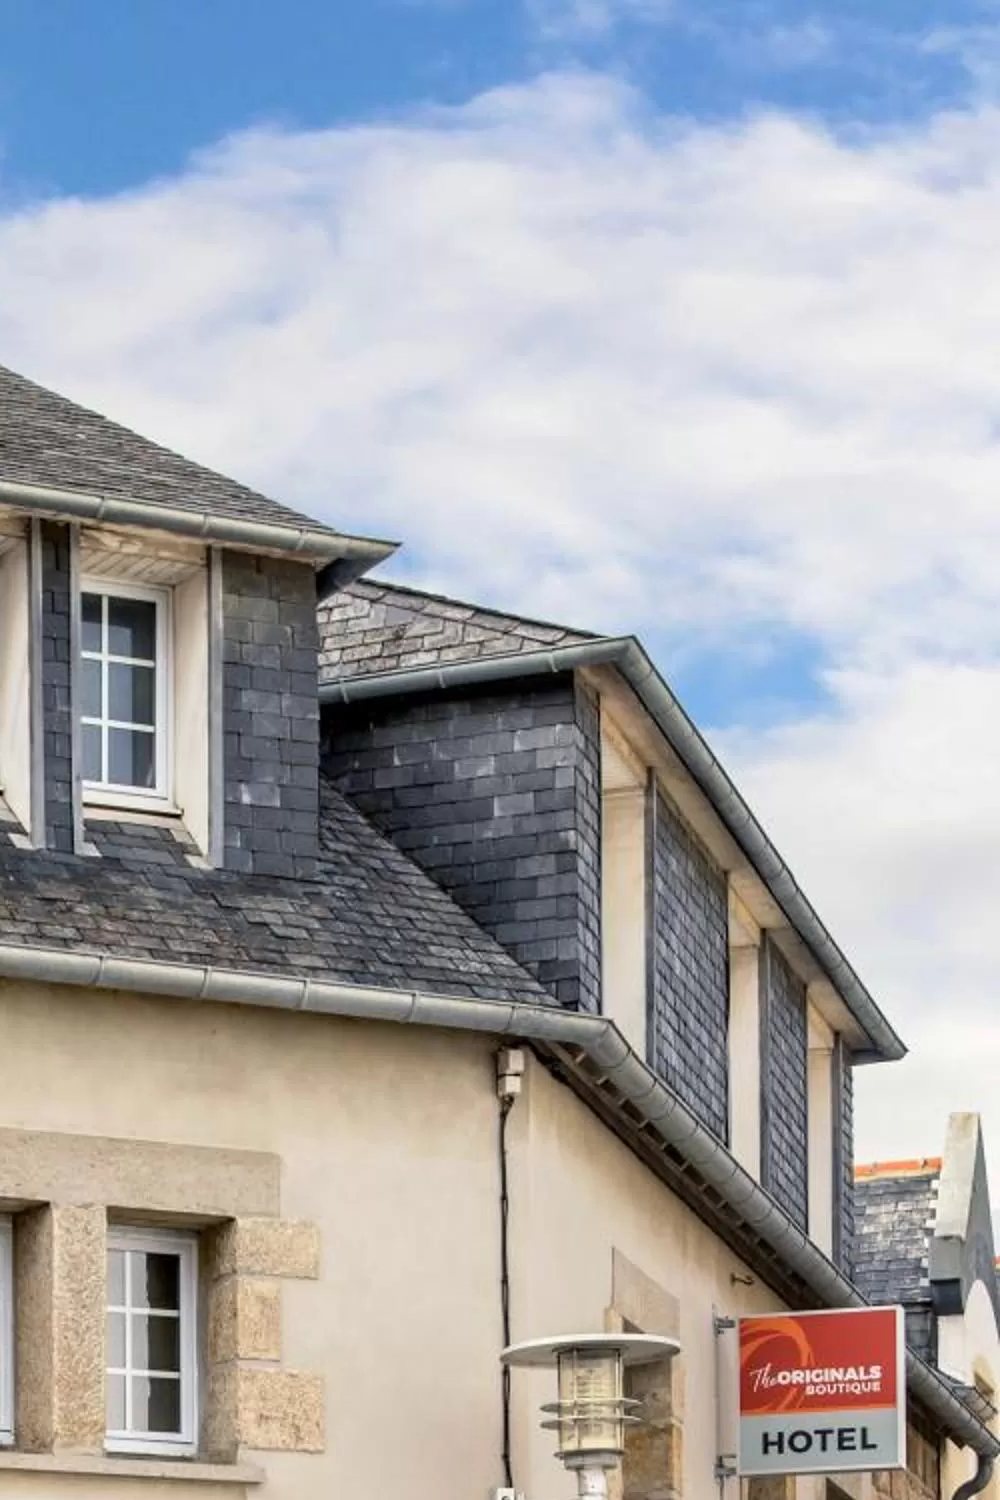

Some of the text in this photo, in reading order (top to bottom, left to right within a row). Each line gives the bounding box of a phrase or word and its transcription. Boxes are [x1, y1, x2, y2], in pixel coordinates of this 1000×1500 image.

[749, 1362, 882, 1392] The ORIGINALS
[805, 1381, 881, 1396] BOUTIQUE
[761, 1427, 878, 1455] HOTEL
